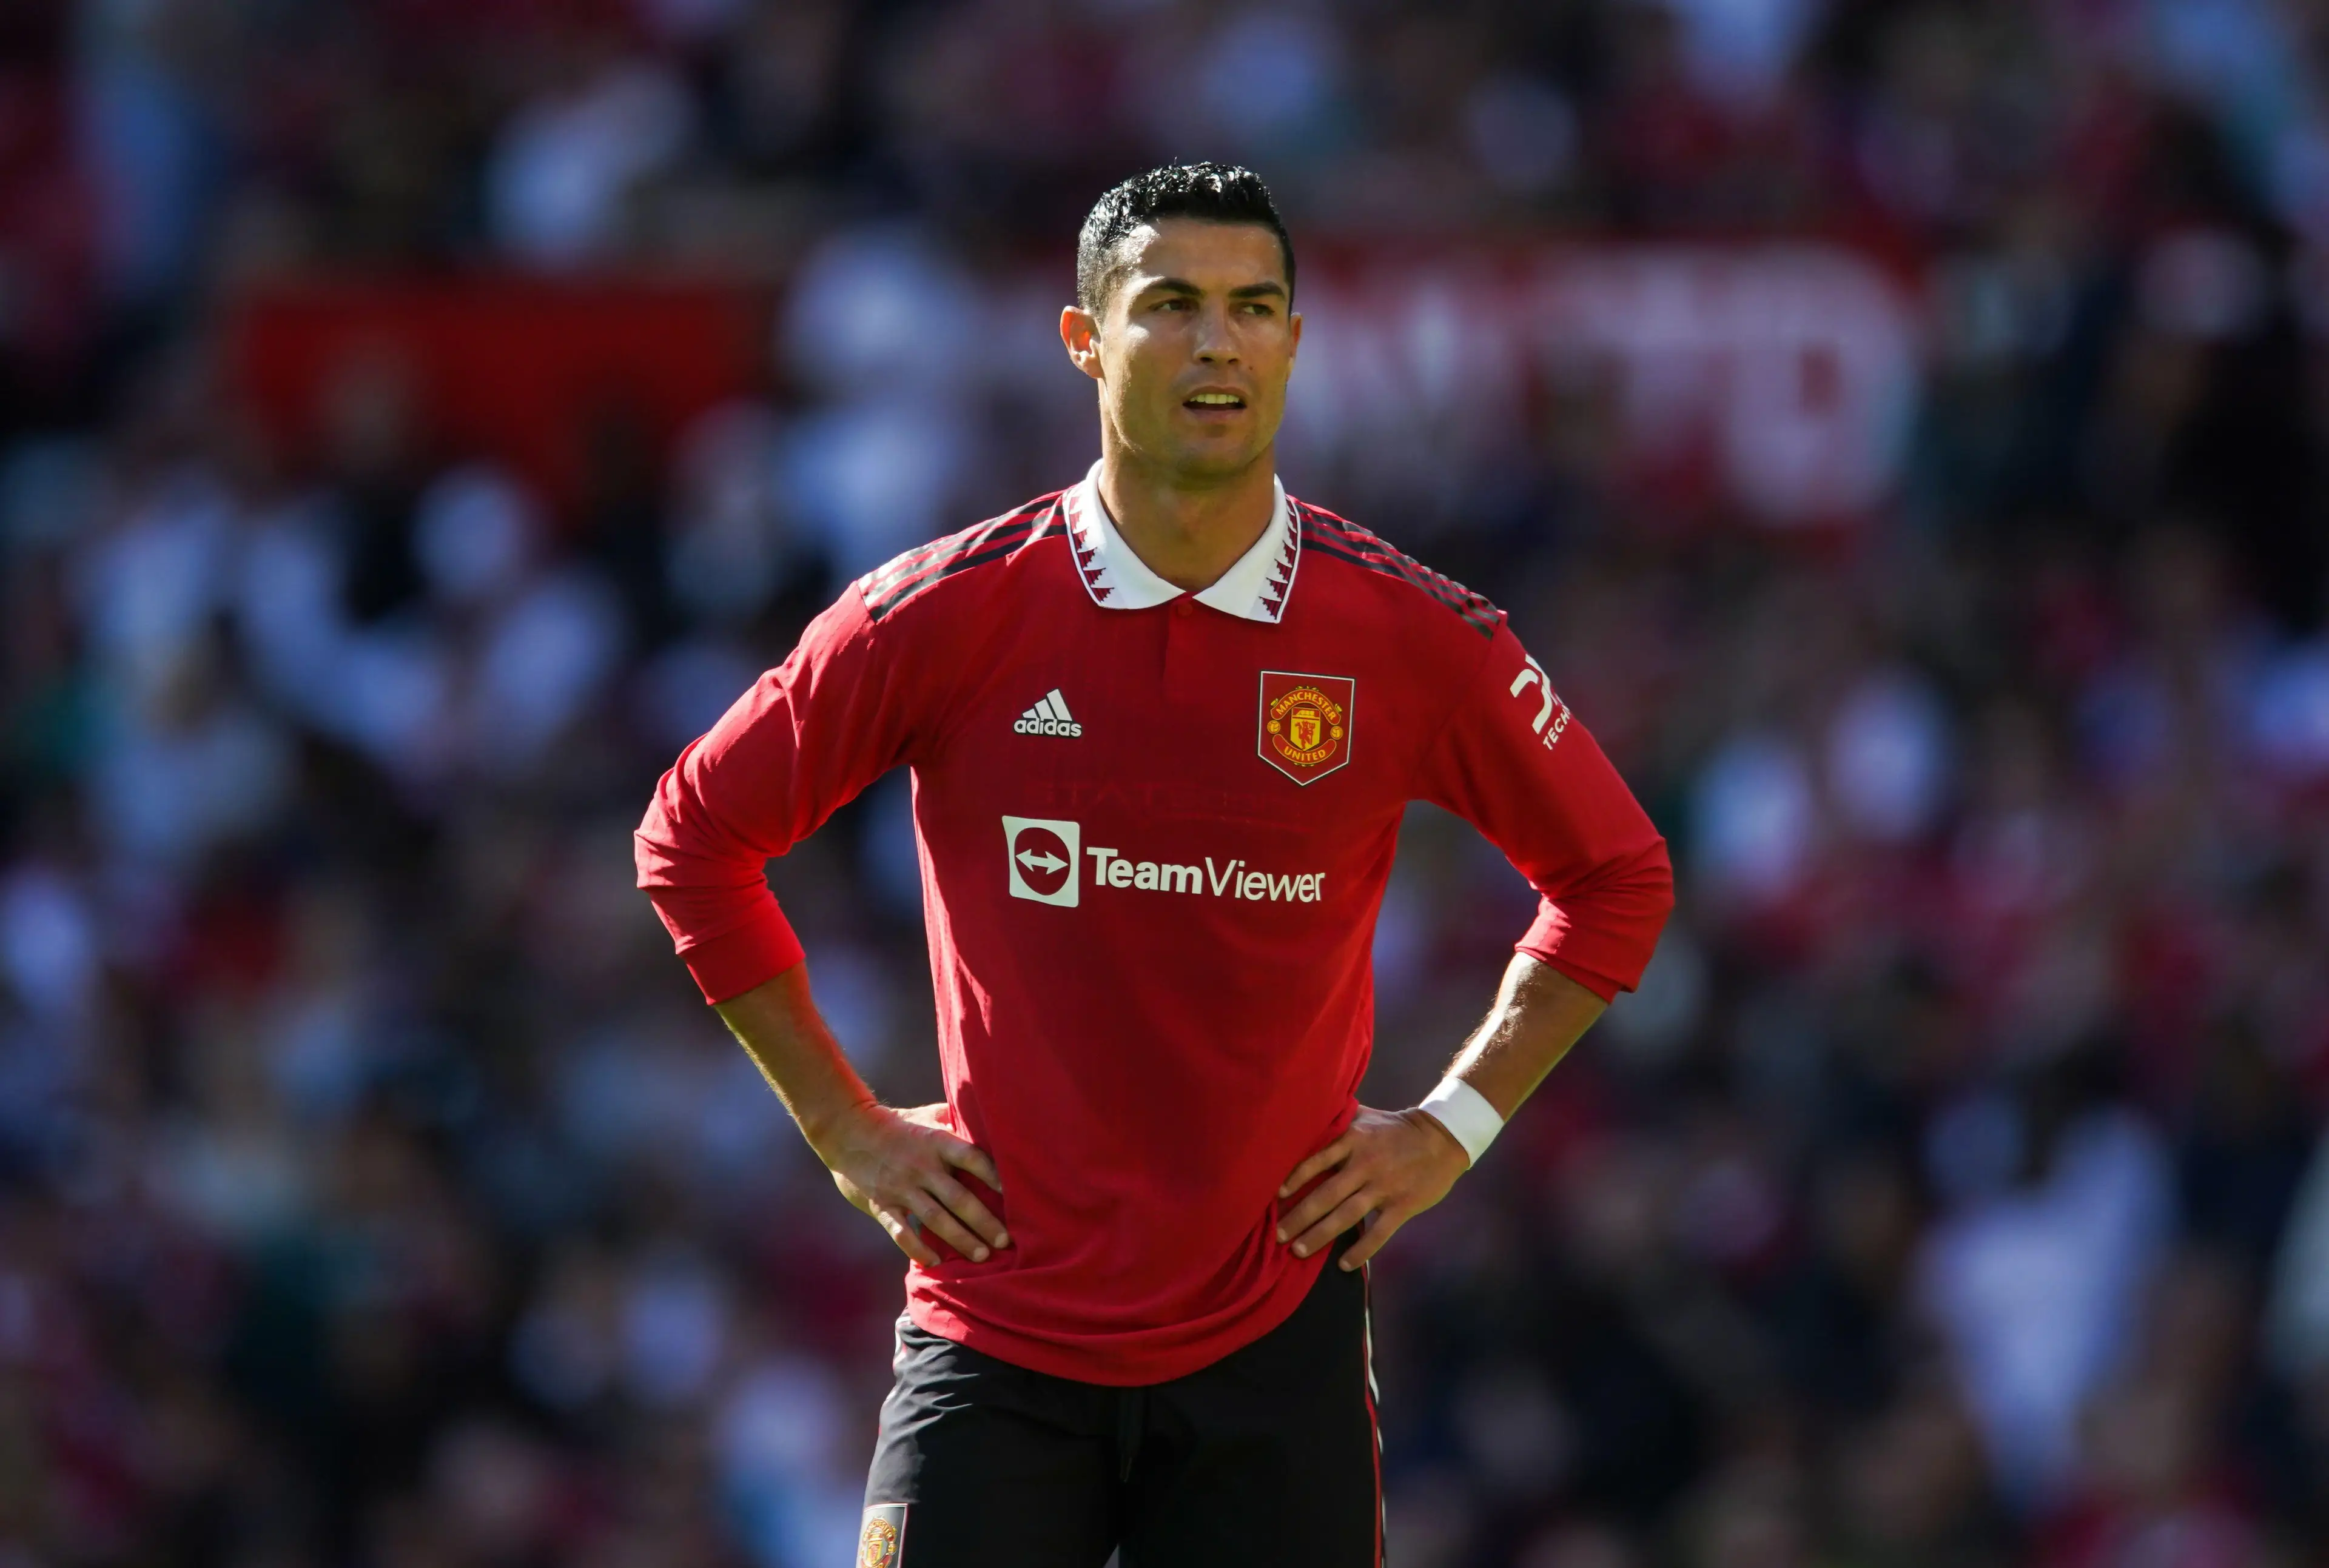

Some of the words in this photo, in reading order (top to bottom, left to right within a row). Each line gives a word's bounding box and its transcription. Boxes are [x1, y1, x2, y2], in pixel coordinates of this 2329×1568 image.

[1275, 691, 1336, 720] MANCHESTER
[1013, 717, 1082, 737] adidas
[1542, 705, 1570, 750] TECH
[1284, 745, 1326, 762] UNITED
[1086, 846, 1326, 903] TeamViewer
